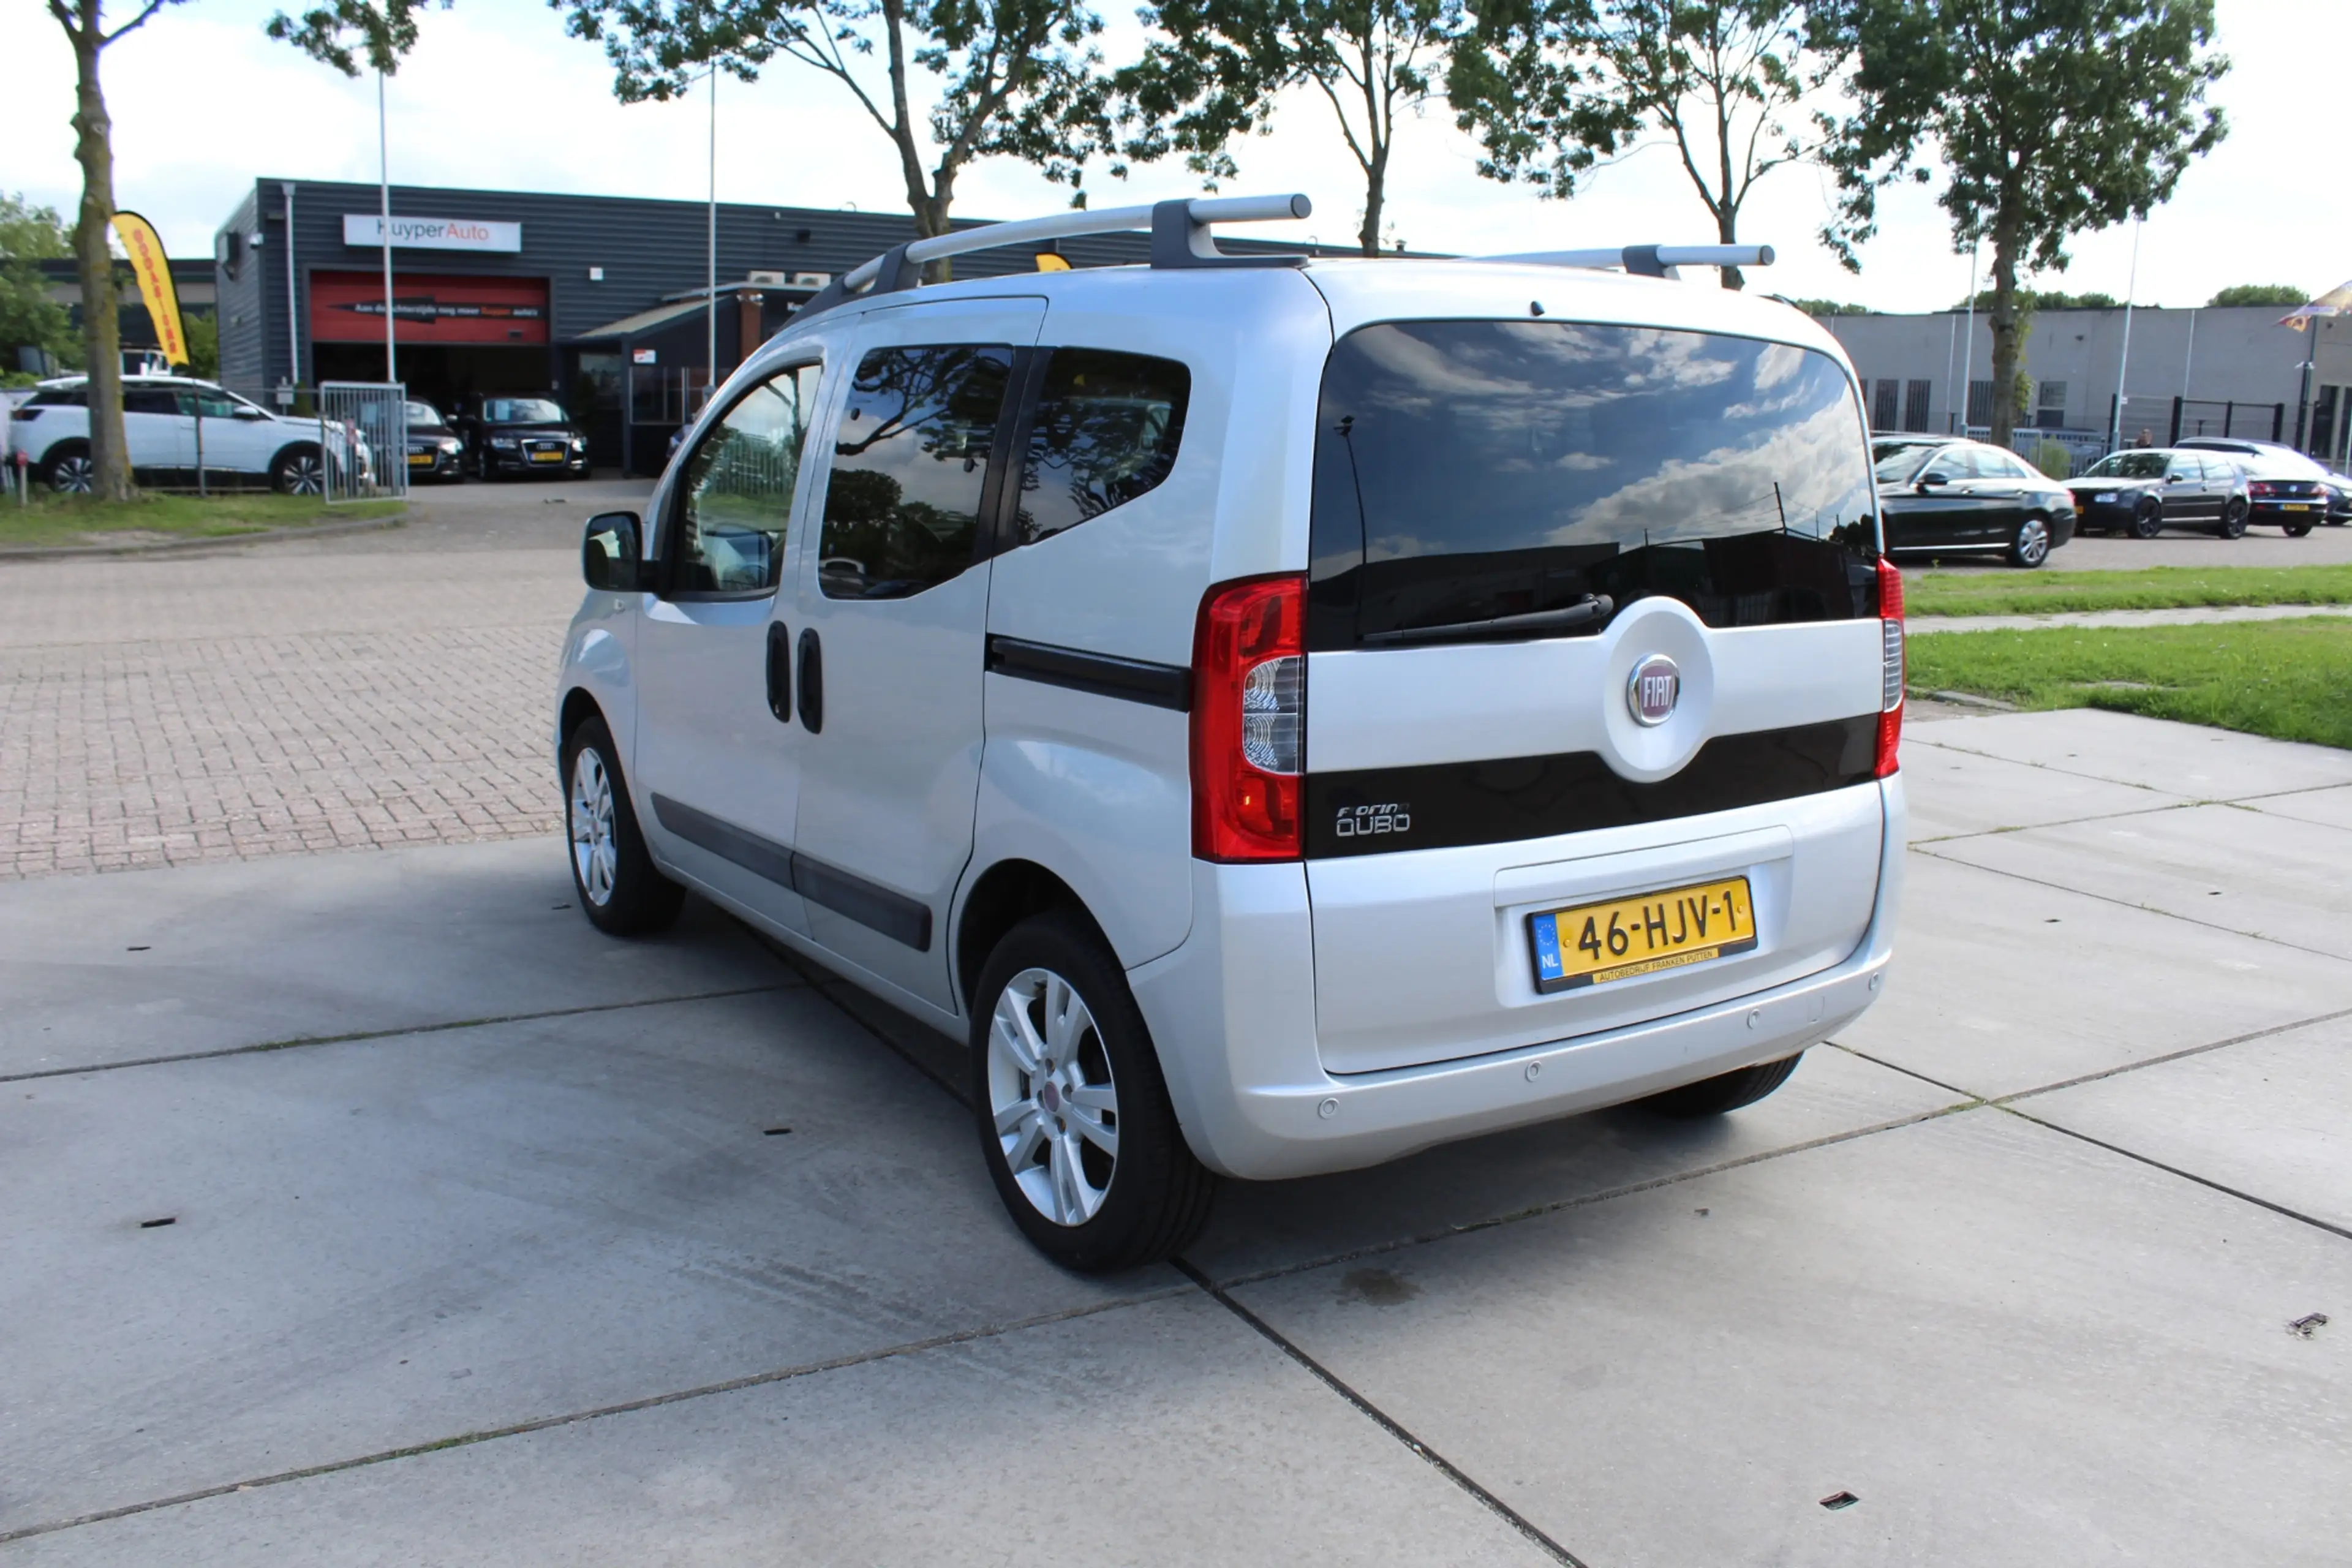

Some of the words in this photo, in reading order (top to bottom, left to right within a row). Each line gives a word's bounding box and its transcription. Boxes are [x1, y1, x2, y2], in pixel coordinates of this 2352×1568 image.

[1643, 676, 1672, 708] FIAT
[1336, 813, 1411, 837] QUBO
[1578, 890, 1736, 960] 46-HJV-1
[1541, 953, 1559, 970] NL
[1599, 963, 1650, 981] AUTOBEDRIJF
[1652, 957, 1685, 971] FRANKEN
[1687, 951, 1713, 962] PUTTEN
